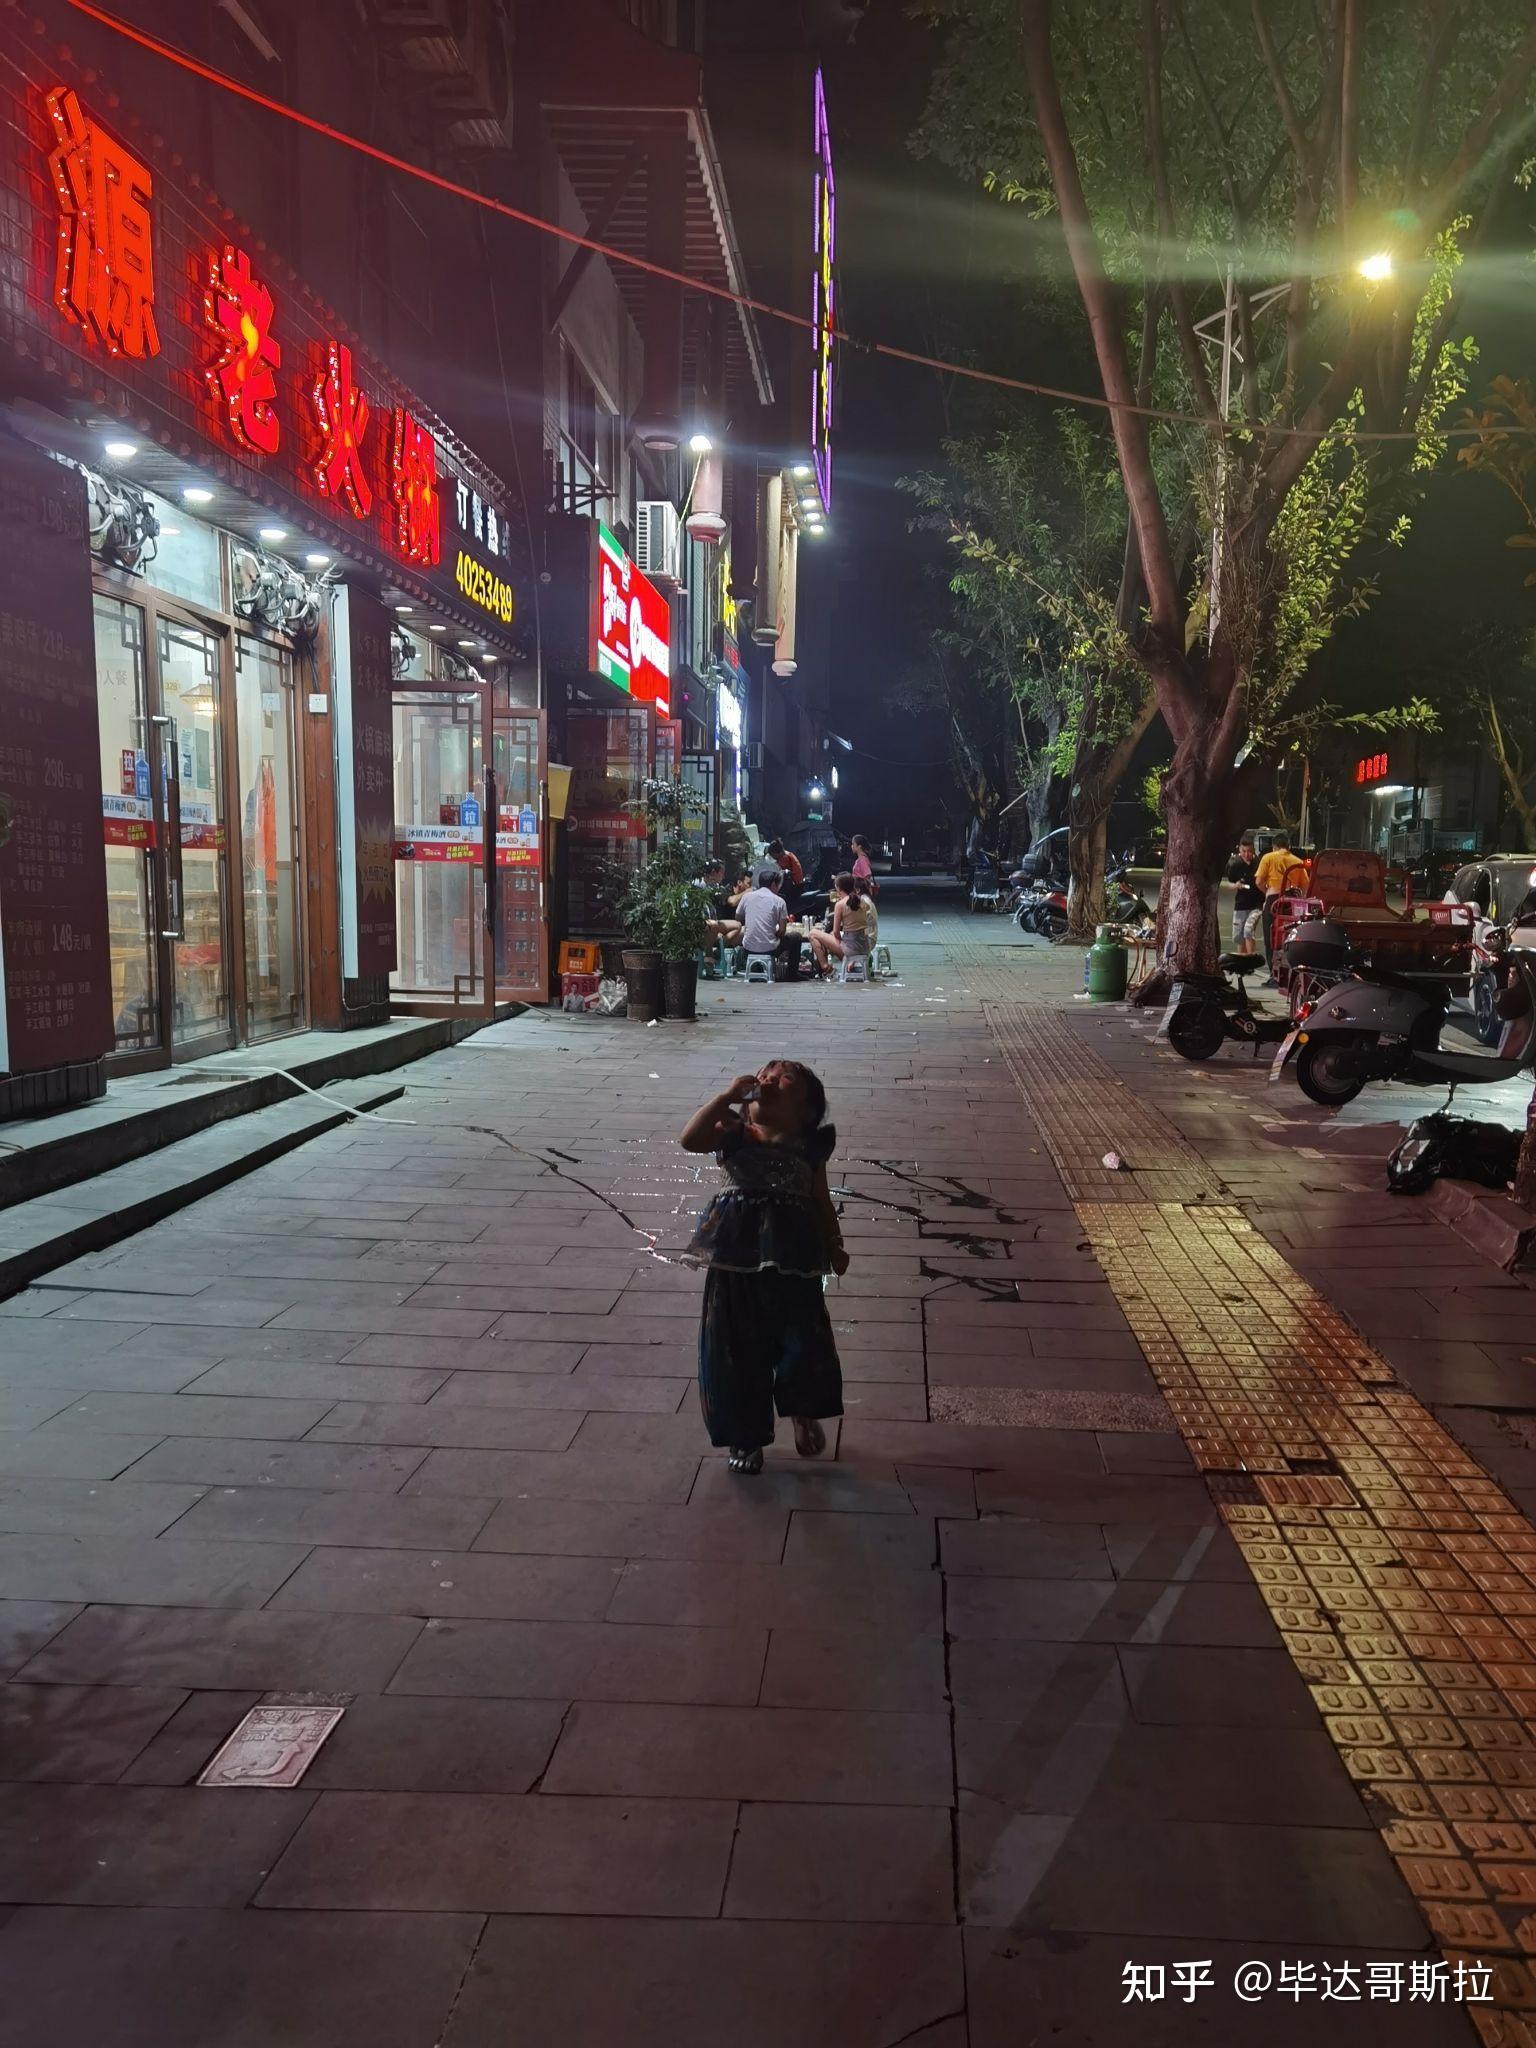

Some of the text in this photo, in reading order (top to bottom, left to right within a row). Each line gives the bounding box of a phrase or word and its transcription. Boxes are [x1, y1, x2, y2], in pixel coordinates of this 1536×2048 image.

[46, 86, 440, 566] 源老火锅
[456, 550, 513, 623] 40253489
